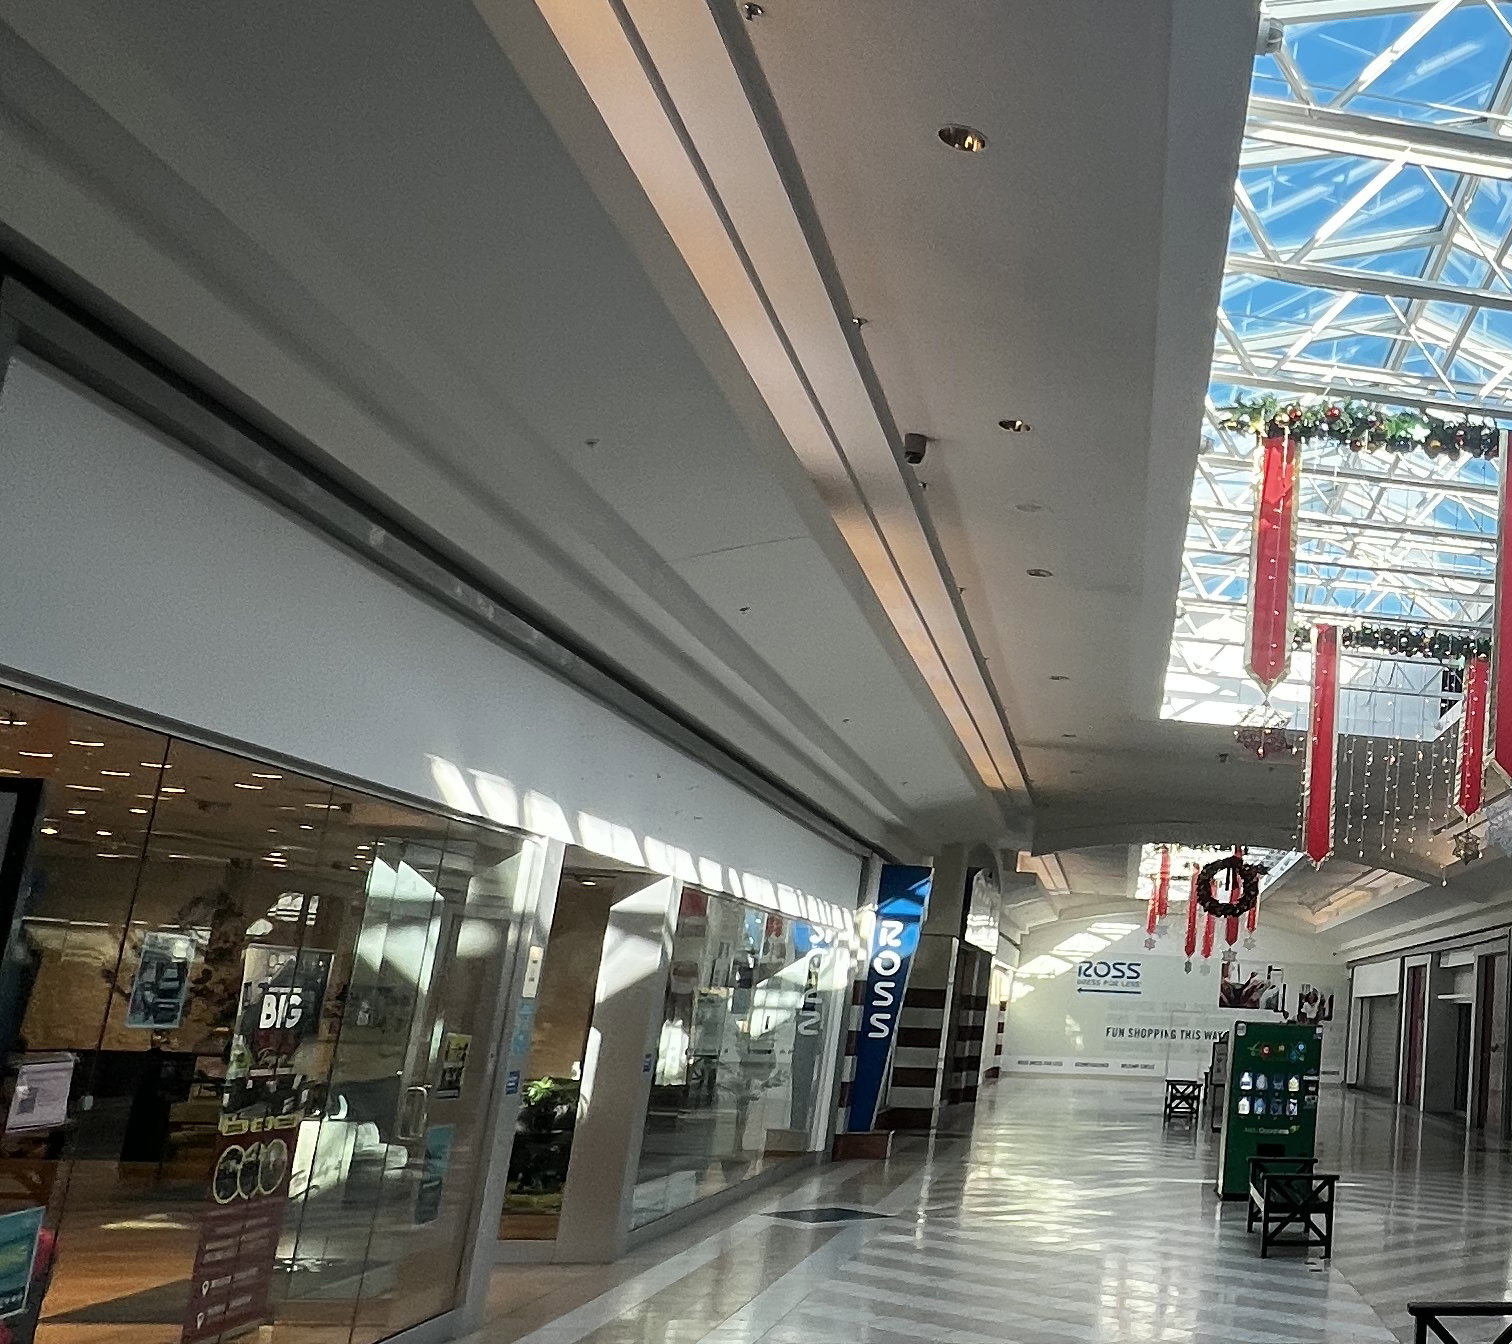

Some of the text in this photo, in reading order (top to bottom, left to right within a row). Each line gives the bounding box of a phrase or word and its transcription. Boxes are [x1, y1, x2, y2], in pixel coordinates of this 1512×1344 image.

[868, 920, 903, 1038] ROSS
[1077, 960, 1142, 979] ROSS
[258, 994, 303, 1029] BIG
[1106, 1027, 1126, 1038] FUN
[1128, 1028, 1177, 1040] SHOPPING
[1180, 1029, 1201, 1040] THIS
